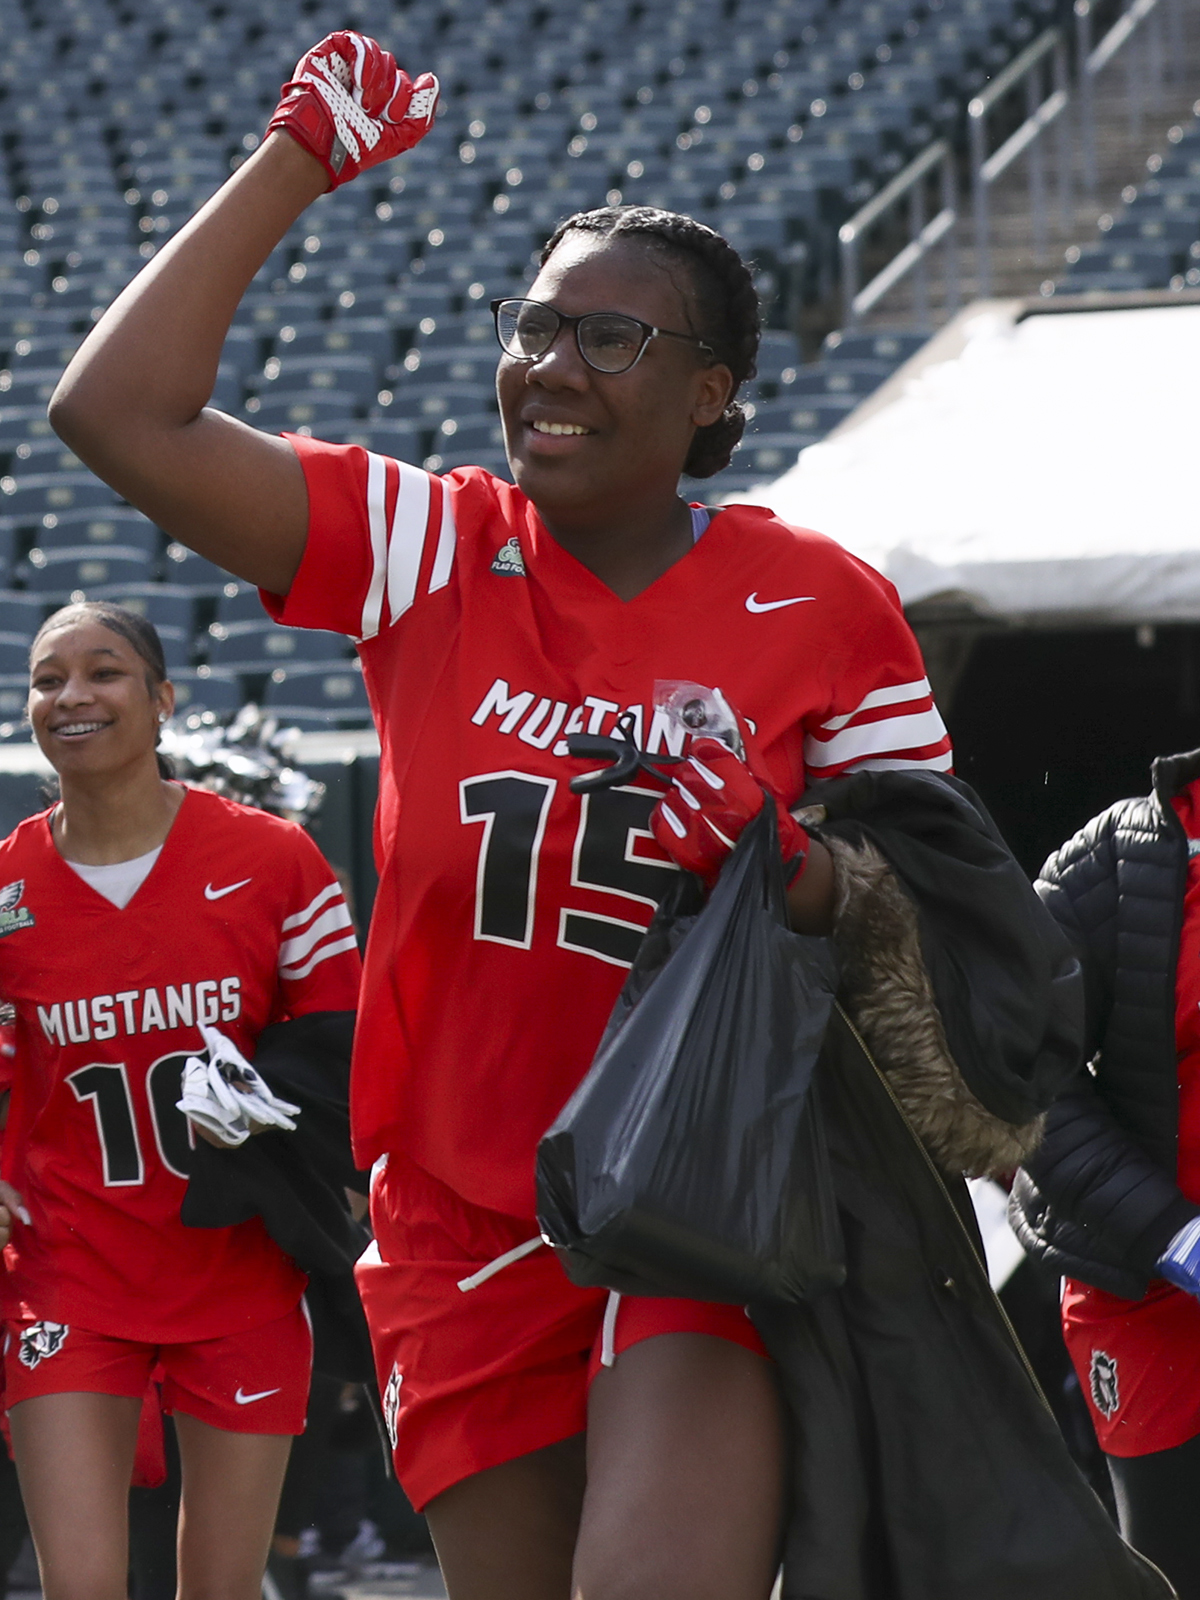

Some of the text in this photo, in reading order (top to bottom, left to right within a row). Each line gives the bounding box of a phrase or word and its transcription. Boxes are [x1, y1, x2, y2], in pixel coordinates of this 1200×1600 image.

[470, 678, 757, 761] MUSTAN
[459, 769, 681, 969] 15
[37, 976, 241, 1046] MUSTANGS
